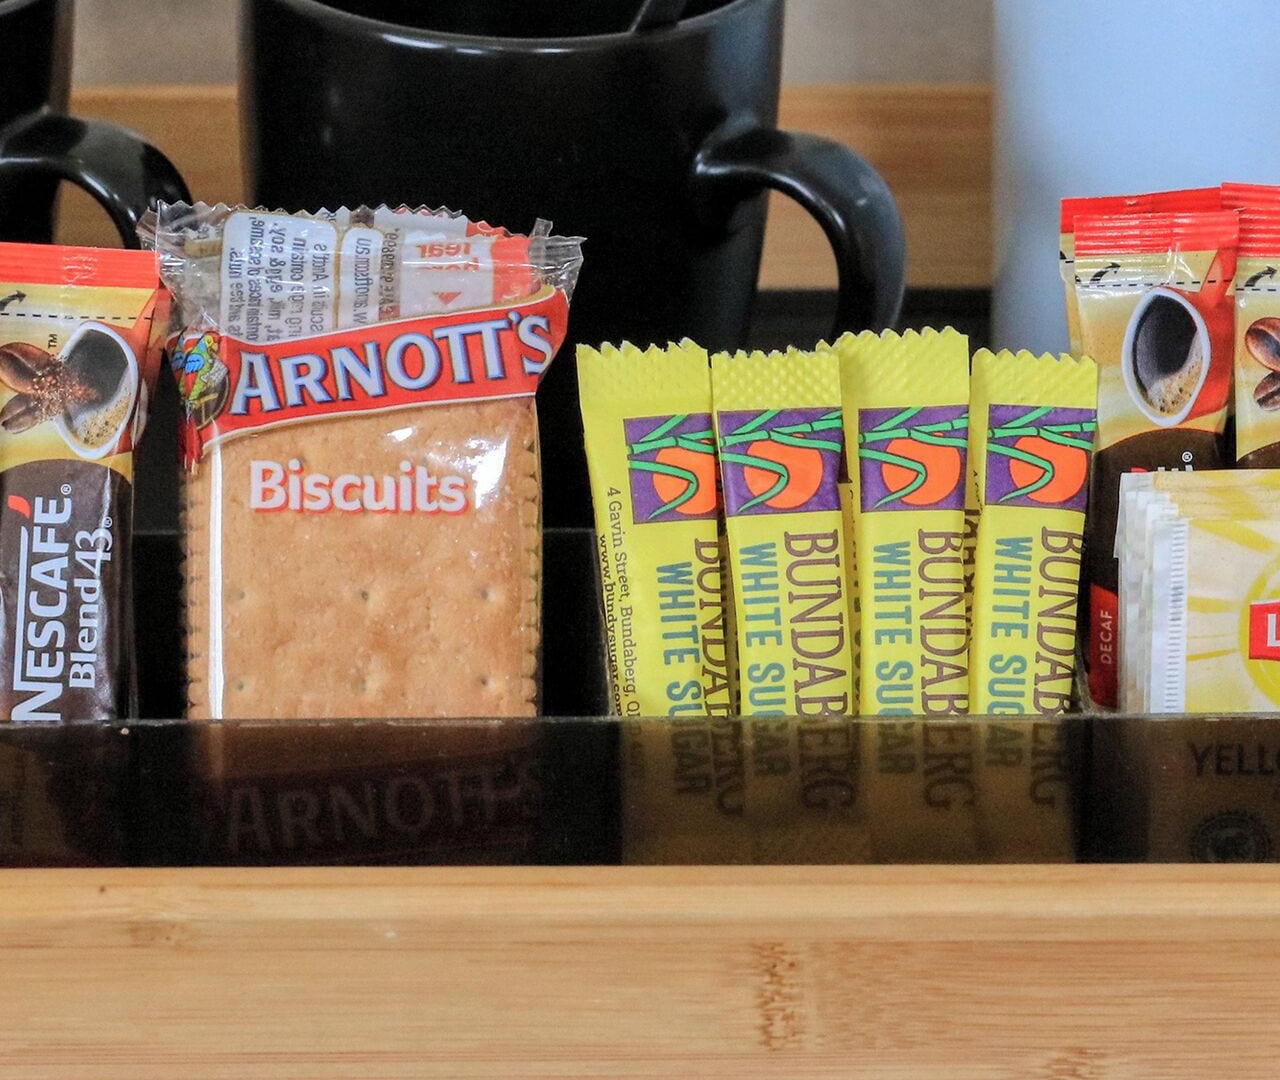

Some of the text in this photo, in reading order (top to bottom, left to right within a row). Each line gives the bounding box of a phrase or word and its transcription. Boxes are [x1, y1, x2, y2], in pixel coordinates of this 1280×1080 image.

[229, 311, 554, 416] ARNOTT'S
[250, 459, 468, 514] Biscuits
[607, 486, 621, 497] 4
[609, 500, 623, 549] Gavin
[615, 552, 630, 602] Street,
[656, 561, 700, 666] WHITE
[739, 541, 783, 648] WHITE
[873, 540, 913, 646] WHITE
[991, 536, 1033, 639] WHITE
[620, 606, 636, 699] Bundaberg,
[1099, 609, 1113, 665] DECAF
